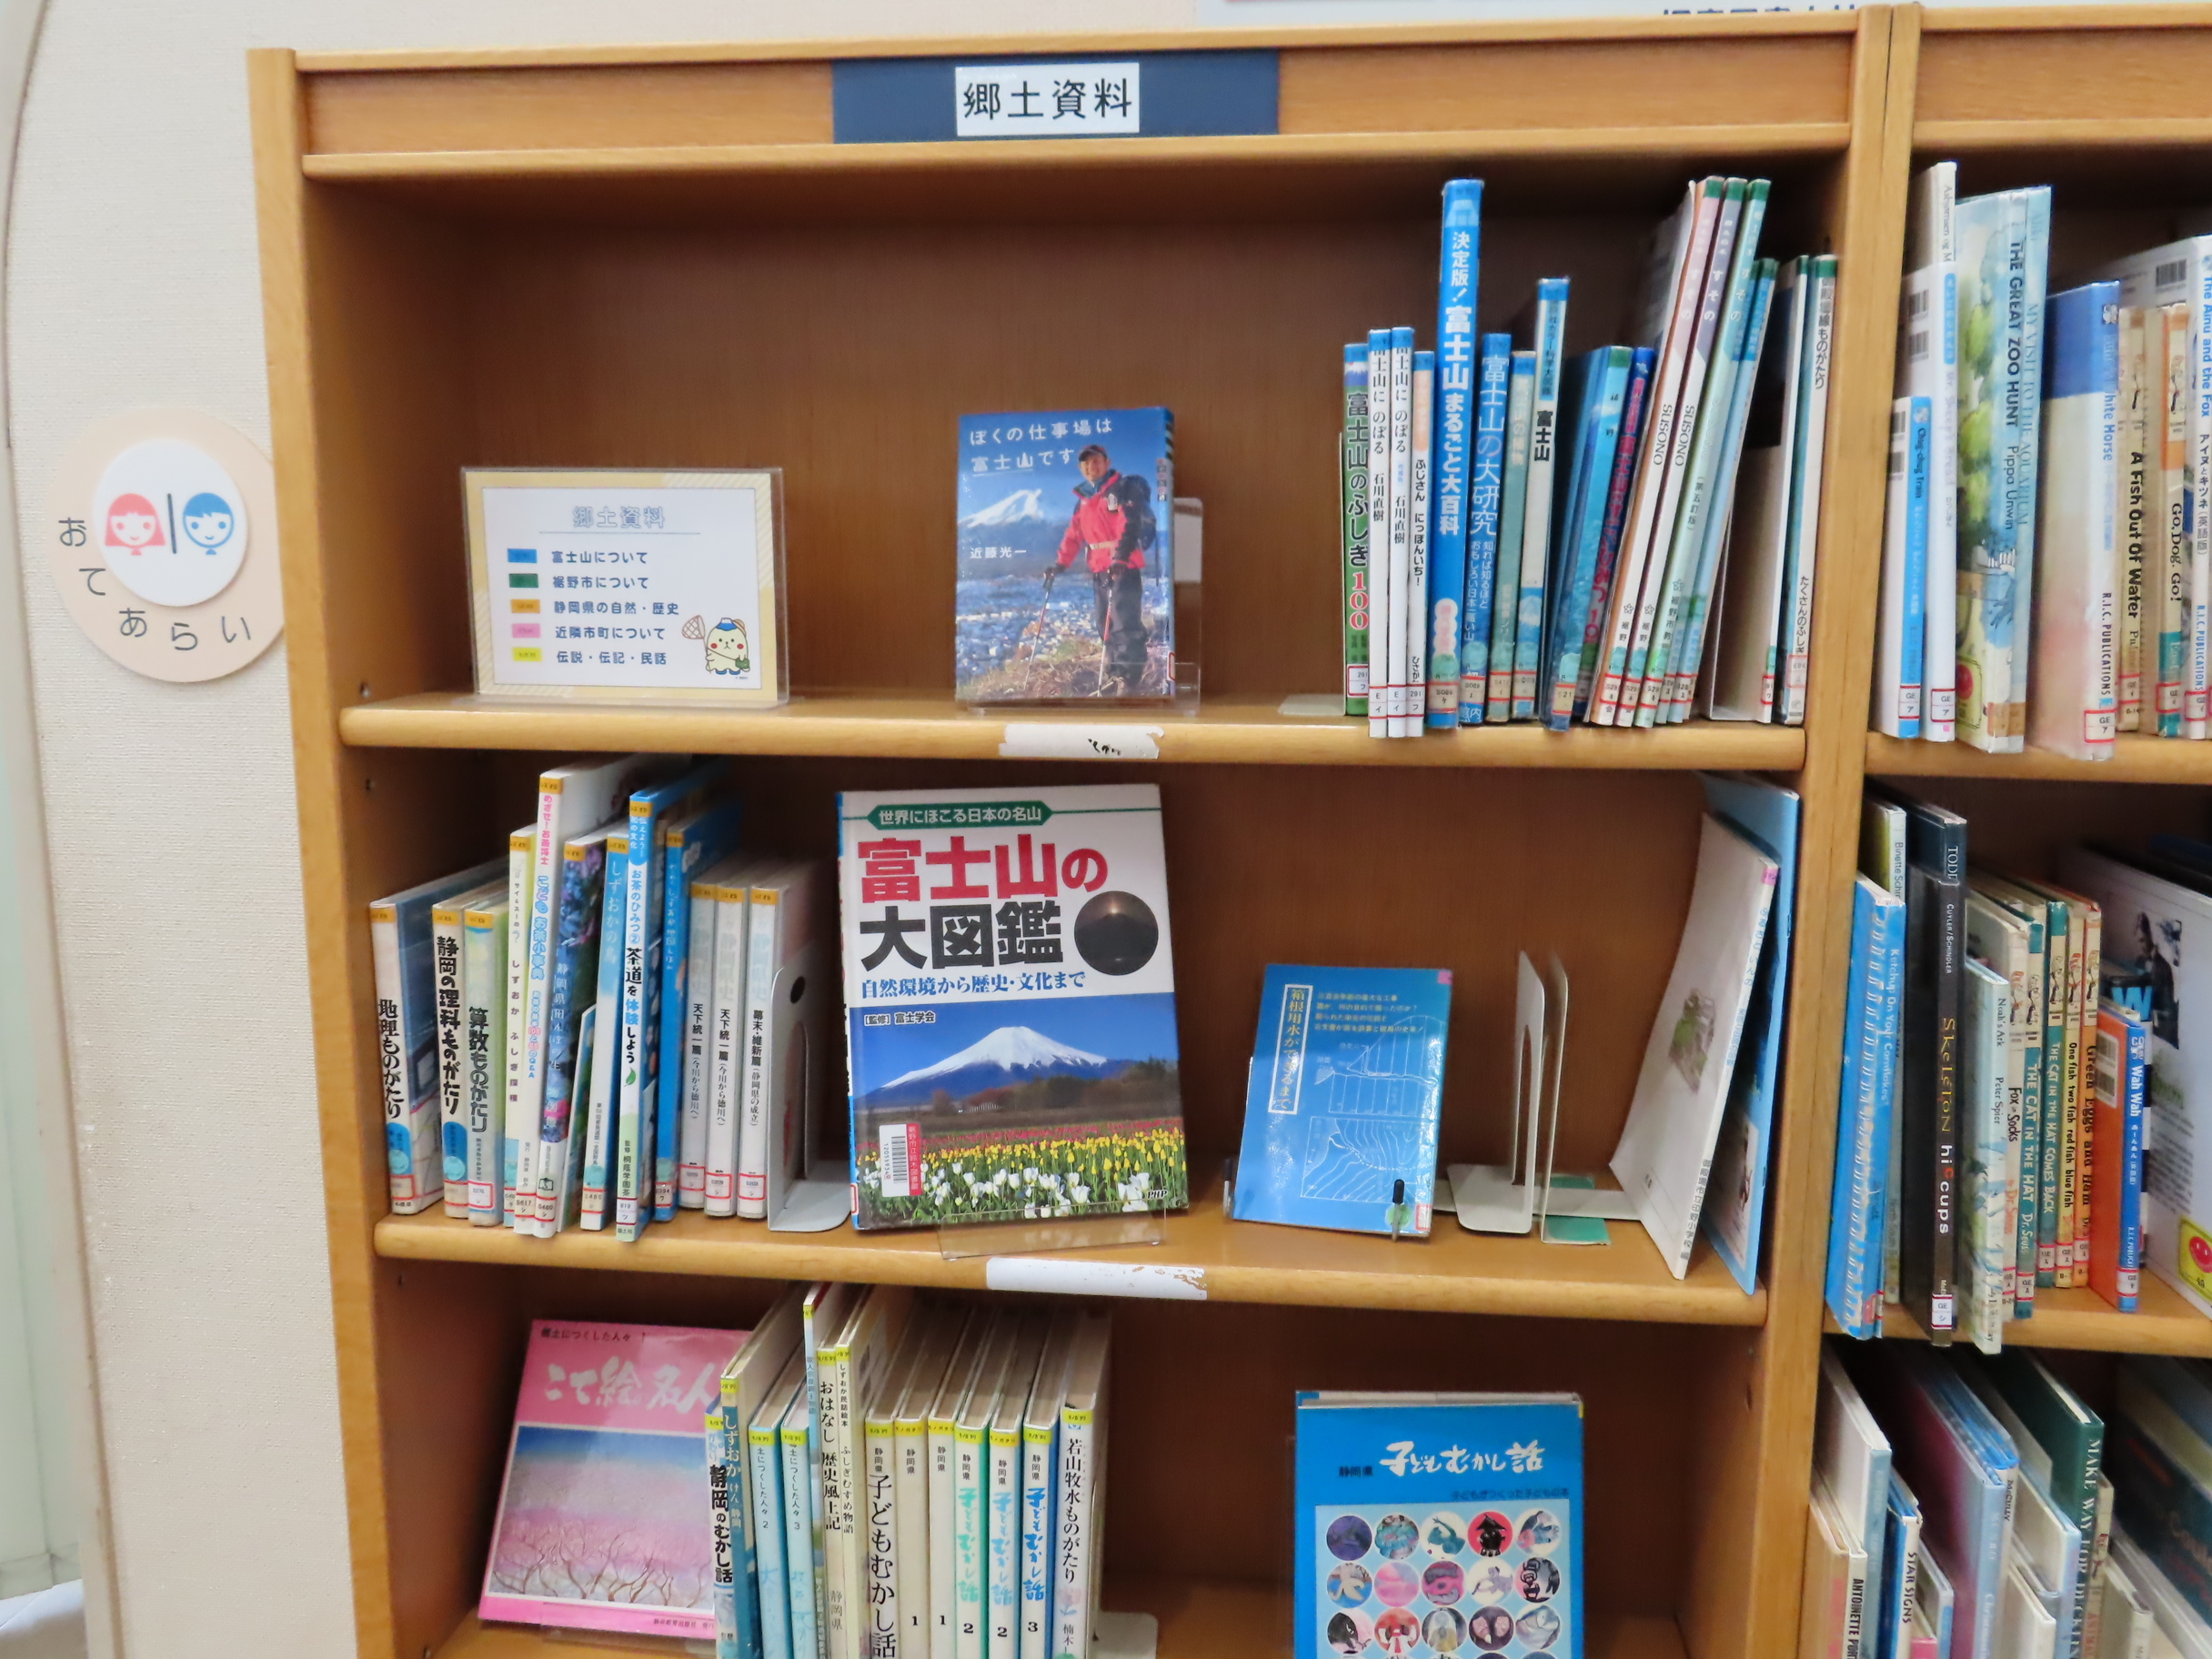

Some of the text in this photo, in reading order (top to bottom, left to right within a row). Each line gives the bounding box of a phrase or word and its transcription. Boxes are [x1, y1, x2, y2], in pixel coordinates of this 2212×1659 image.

[964, 78, 1132, 120] 郷土資料
[1704, 269, 1724, 322] すその
[2005, 242, 2024, 427] THE GREAT ZOO HUNT
[2201, 276, 2212, 417] The Ainu and the Fox
[970, 417, 1113, 447] ぼくの仕事場は
[1469, 354, 1511, 536] 富士山の大研究
[1534, 409, 1553, 461] 富士山
[1653, 404, 1673, 466] SUSONO
[1674, 405, 1695, 468] SUSONO
[2103, 423, 2116, 461] Horse
[970, 447, 1075, 473] 富士山です
[1414, 459, 1426, 502] ふじさん
[1914, 427, 1926, 498] Chug-chug Train
[2131, 451, 2143, 465] A
[1347, 392, 1369, 629] 富士山のふしぎ100
[1372, 473, 1385, 522] 石川直樹
[2004, 490, 2017, 530] Unwin
[2130, 469, 2144, 505] Fish
[573, 506, 666, 528] 郷土資料
[1393, 497, 1406, 544] 石川直樹
[2128, 508, 2144, 539] Out
[551, 550, 648, 564] 富士山について
[970, 547, 1027, 559] 近藤光一
[1479, 540, 1495, 608] 知れば知るほど
[58, 517, 251, 651] おてあらい
[553, 576, 649, 589] 裾野市について
[2127, 570, 2143, 618] Water
[2170, 571, 2182, 601] Go!
[554, 601, 679, 616] 静岡県の自然・歴史
[555, 626, 666, 640] 近隣市町について
[2100, 592, 2112, 696] R.I.C. PUBLICATIONS
[557, 650, 667, 666] 伝説・伝記・民話
[2195, 630, 2206, 691] PUBLICATIONS
[879, 807, 1042, 827] 世界にほこる日本の名山
[858, 833, 1109, 903] 富士山の
[1894, 841, 1904, 872] Binette
[859, 900, 1063, 972] 大図鑑
[624, 947, 643, 1064] 茶道を体験しよう
[860, 970, 1087, 1000] 自然環境から歴史・文化まで
[1885, 949, 1900, 1040] Ketchup On Your
[436, 936, 462, 1115] 静岡の理科ものがたり
[894, 1010, 937, 1025] 富士学会
[1996, 997, 2006, 1047] Noah's Ark
[377, 998, 405, 1120] 地理ものがたり
[468, 1006, 489, 1133] 算数ものがたり
[1278, 988, 1305, 1110] 箱根用水ができるまで
[1994, 1077, 2005, 1125] Peter Spier
[2006, 1087, 2023, 1142] Fox Socks
[2129, 1065, 2143, 1117] Wah Wah
[2022, 1063, 2038, 1202] THE CAT IN THE HAT
[2043, 1042, 2061, 1213] THE CAT IN THE HAT COMES BACK
[2064, 1042, 2078, 1209] One fish two fish red fish blue fish
[1146, 1189, 1168, 1200] PHP
[2021, 1213, 2034, 1228] Dr.
[723, 1414, 742, 1503] しずおか けん
[819, 1381, 841, 1531] おはなし 歴史風土記
[874, 1447, 884, 1473] 静岡県
[906, 1448, 916, 1474] 静岡県
[937, 1445, 947, 1473] 静岡県
[961, 1453, 971, 1481] 静岡県
[998, 1459, 1008, 1485] 静岡県
[1031, 1453, 1041, 1481] 静岡県
[1339, 1465, 1373, 1478] 静岡県
[1379, 1439, 1545, 1477] 子どもむかし話
[757, 1446, 769, 1529] 土につくした人々 2
[789, 1443, 800, 1530] 土につくした人々 3
[840, 1446, 854, 1533] ふしぎむすめ物語
[2079, 1439, 2101, 1531] MAKE WAY
[709, 1464, 733, 1584] 静岡のむかし話
[1062, 1438, 1081, 1584] 若山牧水ものがたり
[867, 1474, 897, 1658] 子どもむかし話
[1902, 1552, 1917, 1624] STAR SIGNS
[830, 1590, 843, 1630] 静岡県
[911, 1615, 919, 1626] 1
[940, 1614, 946, 1625] 1
[963, 1623, 974, 1634] 2
[1027, 1622, 1039, 1633] 3
[1848, 1578, 1865, 1635] ANTOINETTE
[997, 1626, 1008, 1637] 2
